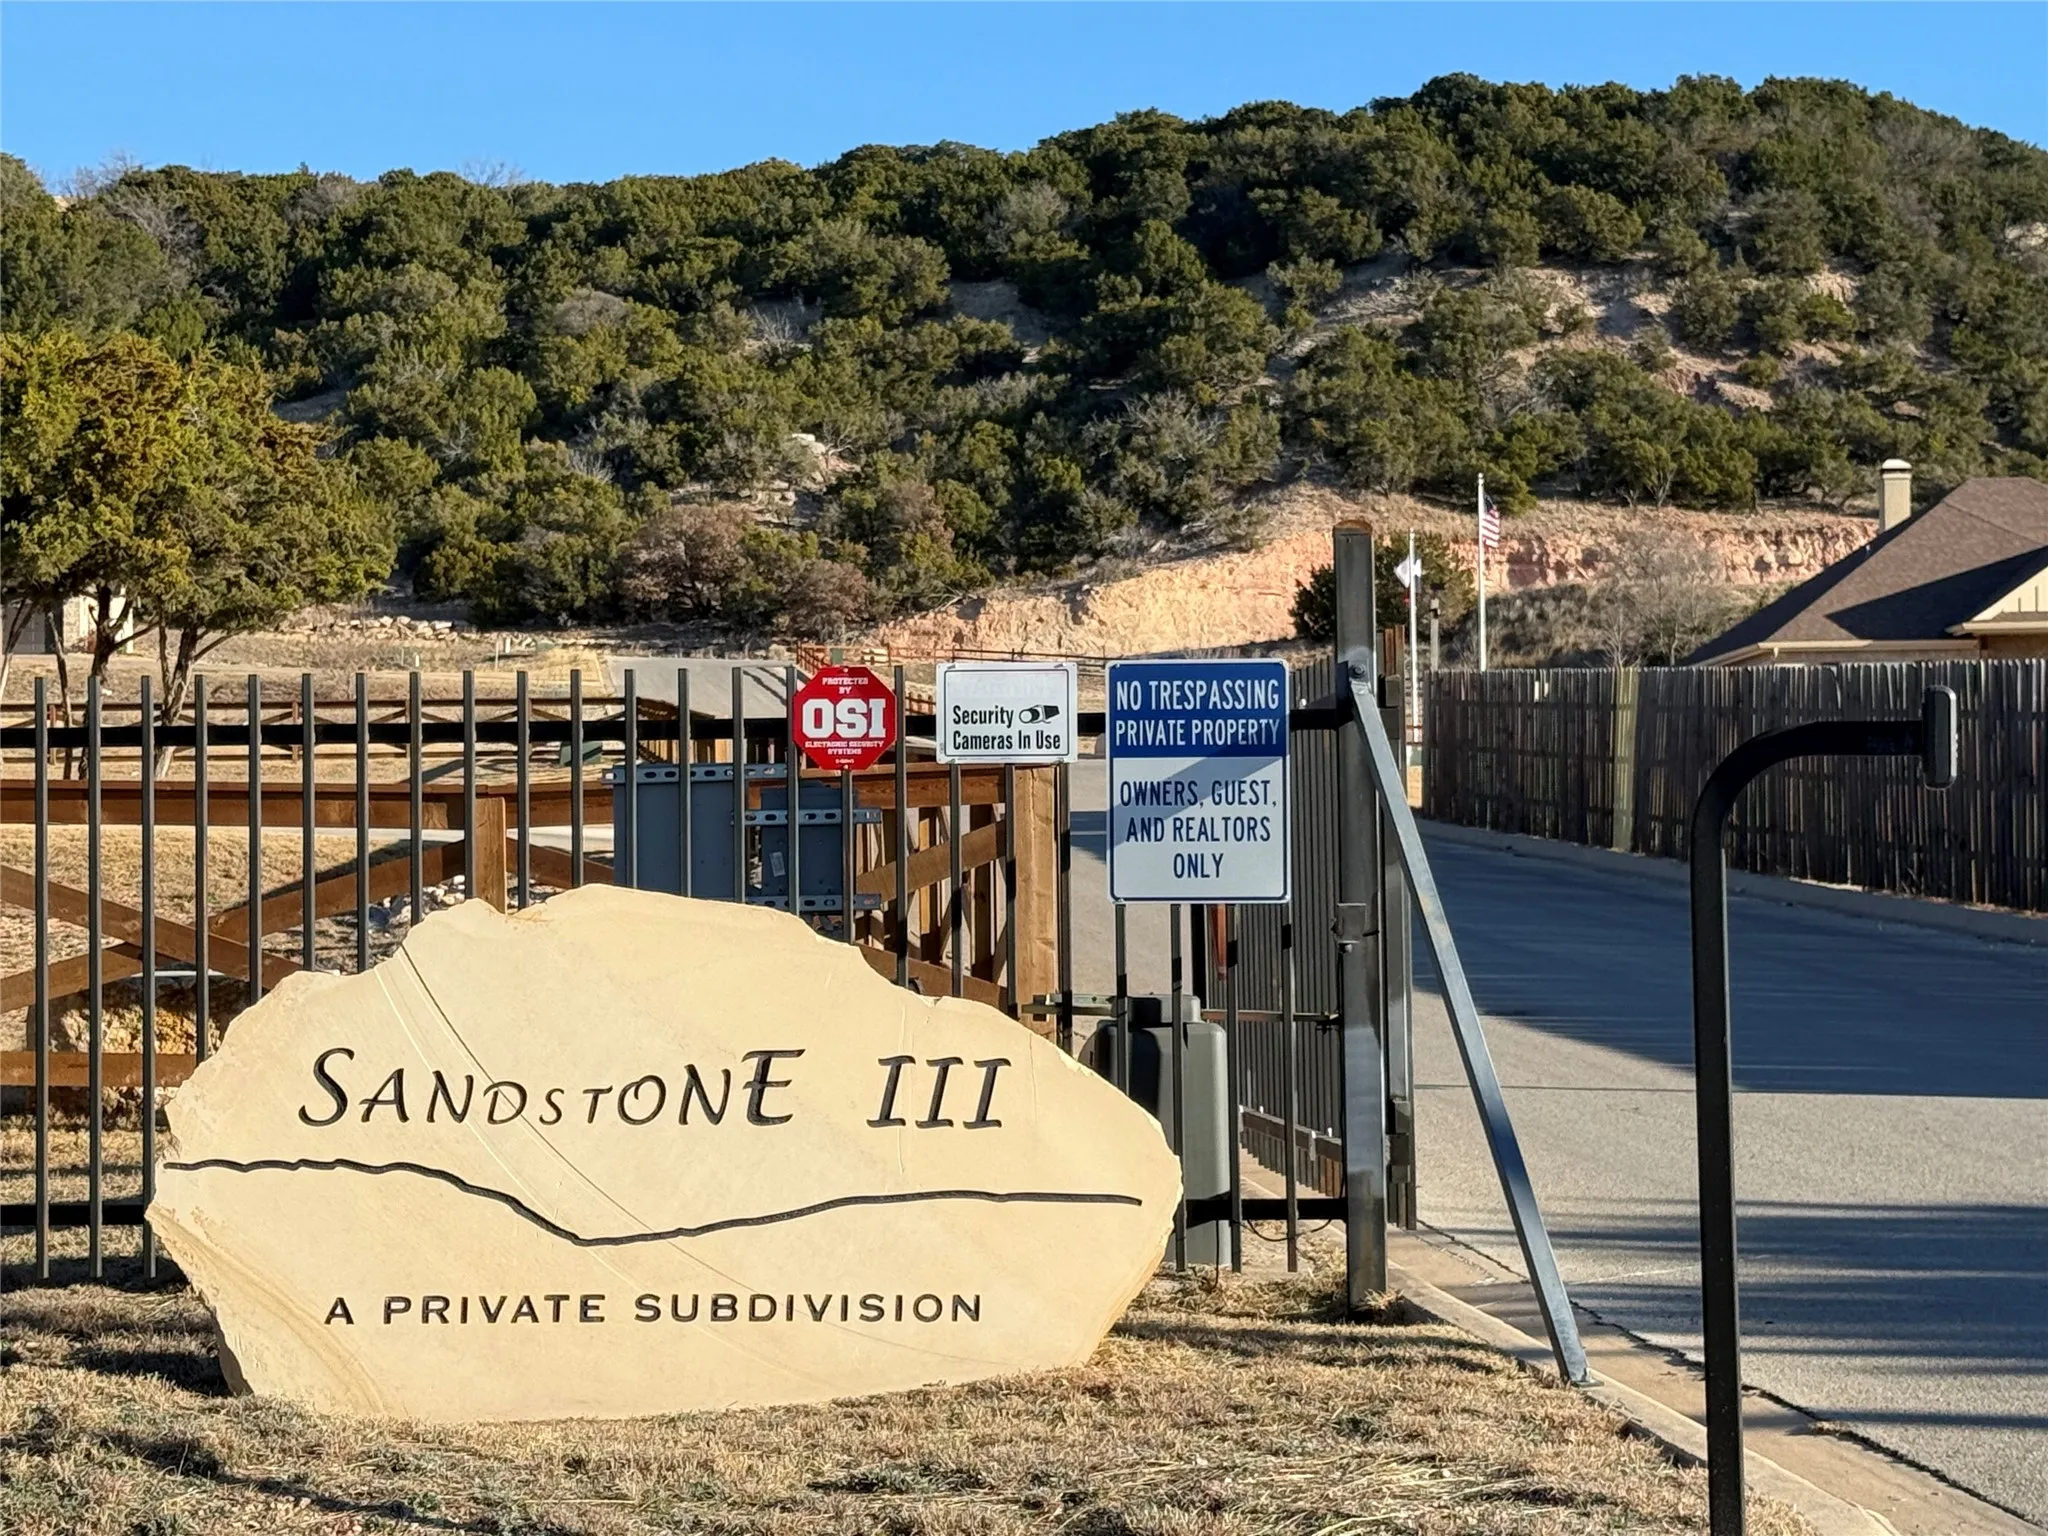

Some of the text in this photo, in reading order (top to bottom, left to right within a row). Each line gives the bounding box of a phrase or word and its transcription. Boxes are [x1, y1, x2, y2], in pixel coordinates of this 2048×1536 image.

[822, 677, 869, 685] PROTECTED
[839, 686, 852, 694] BY
[1116, 679, 1279, 711] NO TRESPASSING
[802, 698, 886, 738] OSI
[952, 704, 1014, 728] Security
[804, 740, 884, 748] ELECTRONIC SECURITY
[953, 730, 1061, 750] Cameras In Use
[1116, 718, 1280, 746] PRIVATE PROPERTY
[1120, 779, 1277, 809] OWNERS, GUEST,
[1126, 816, 1271, 842] AND REALTORS
[1173, 853, 1224, 878] ONLY
[298, 1047, 1011, 1129] SANDSTONE III
[324, 1293, 981, 1325] A PRIVATE SUBDIVISION
